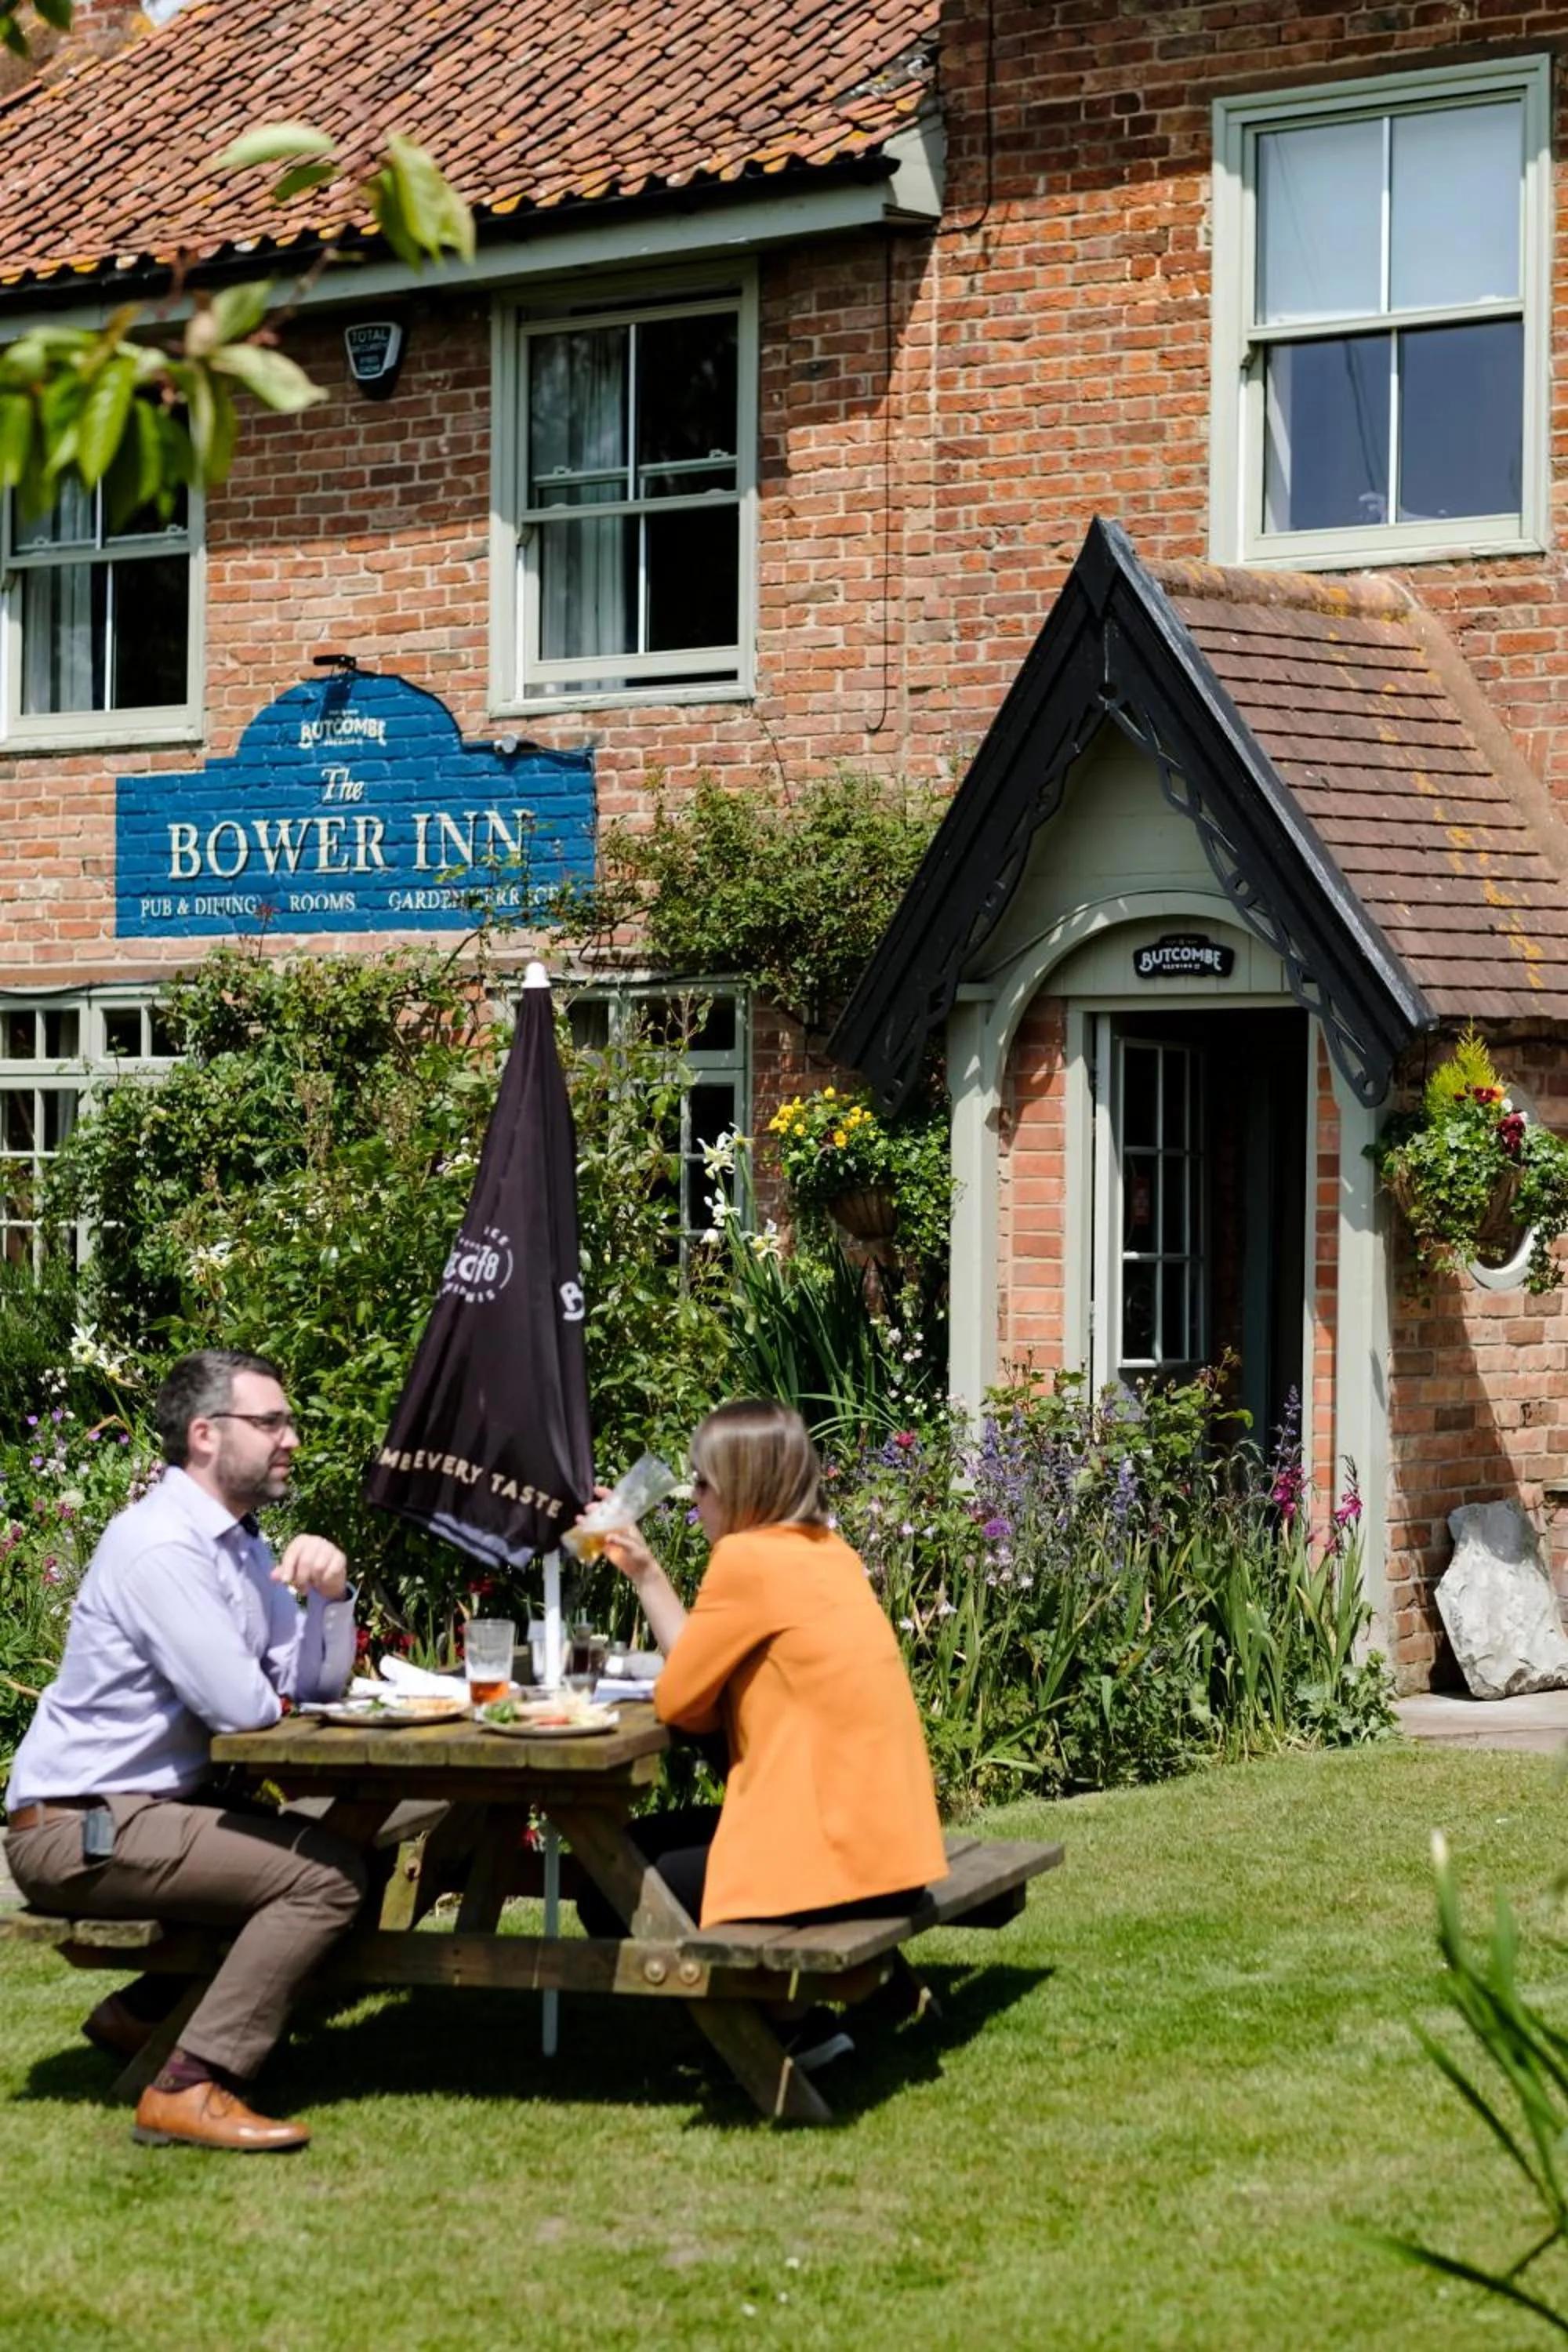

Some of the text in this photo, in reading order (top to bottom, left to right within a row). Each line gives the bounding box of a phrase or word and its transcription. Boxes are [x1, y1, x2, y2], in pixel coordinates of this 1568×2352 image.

[350, 329, 388, 343] TOTAL
[299, 717, 387, 749] BUTCOMBE
[321, 767, 365, 802] The
[167, 809, 535, 880] BOWER INN
[141, 898, 172, 917] PUB
[177, 902, 189, 916] &
[194, 895, 257, 916] DINING
[289, 892, 356, 912] ROOMS
[388, 888, 465, 910] GARDEN
[1139, 947, 1222, 971] BUTCOMBE
[413, 1450, 484, 1484] EVERY
[491, 1472, 564, 1519] TASTE
